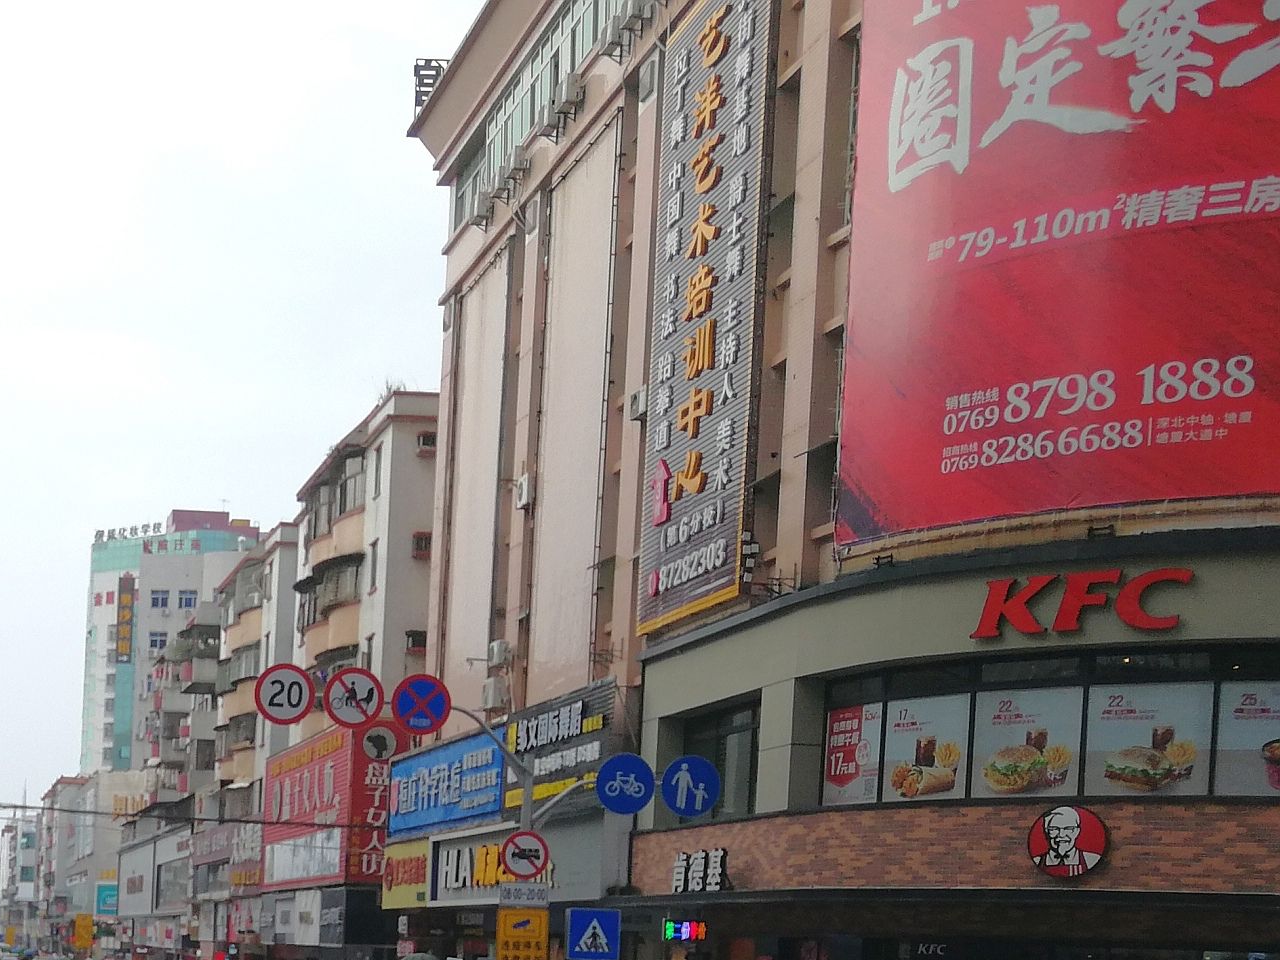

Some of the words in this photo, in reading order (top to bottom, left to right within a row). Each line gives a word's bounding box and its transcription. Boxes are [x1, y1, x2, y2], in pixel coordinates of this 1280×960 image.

[670, 47, 691, 149] 拉丁舞
[665, 160, 685, 261] 中国舞
[660, 272, 679, 341] 书法
[717, 299, 740, 406] 主持人
[654, 352, 676, 451] 跆拳道
[943, 405, 1000, 435] 0769
[1004, 369, 1117, 423] 8798
[1136, 355, 1256, 405] 1888
[713, 418, 736, 491] 美术
[941, 454, 979, 474] 0769
[659, 539, 727, 592] 87282303
[969, 567, 1196, 640] KFC
[268, 679, 303, 709] 20
[442, 846, 472, 889] HLA
[671, 848, 725, 893] 肯德基
[918, 943, 947, 956] KFC
